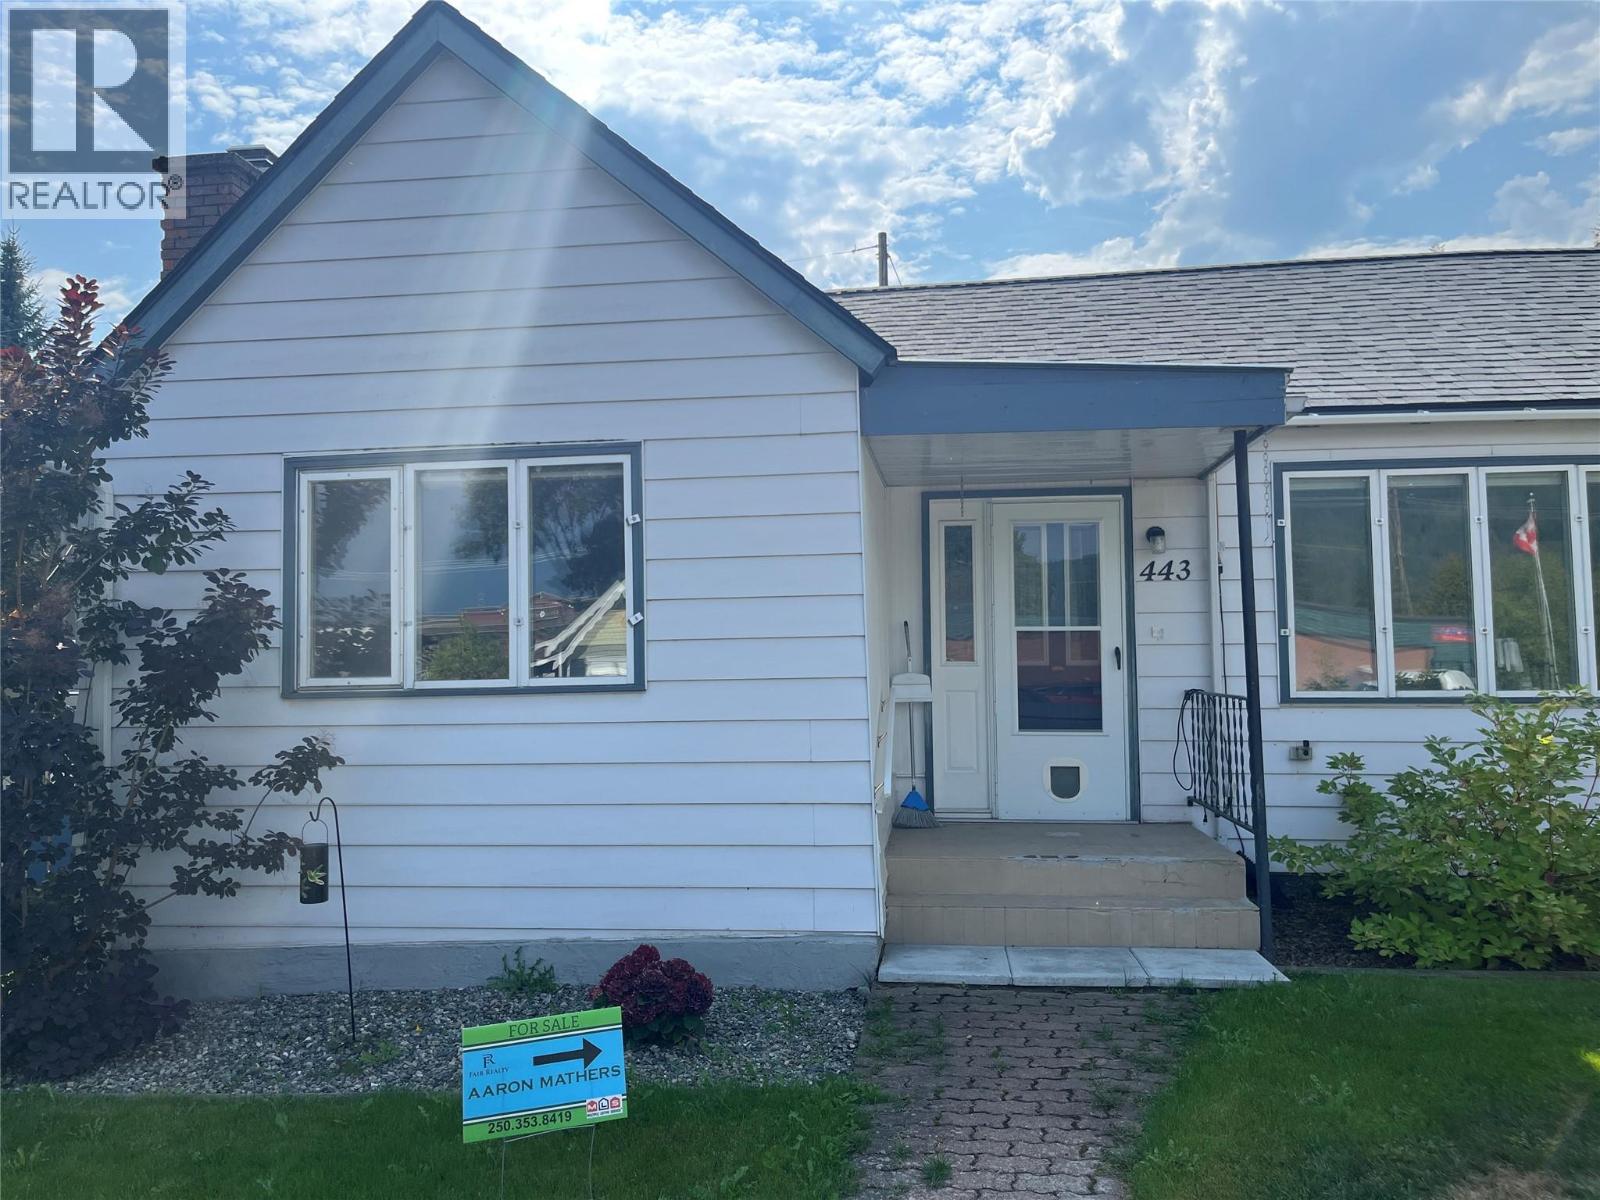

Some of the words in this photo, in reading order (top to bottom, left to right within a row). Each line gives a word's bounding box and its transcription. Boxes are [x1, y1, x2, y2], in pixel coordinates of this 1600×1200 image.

[1139, 559, 1191, 582] 443
[508, 1022, 539, 1038] FOR
[543, 1015, 581, 1033] SALE
[468, 1079, 534, 1100] AARON
[540, 1065, 621, 1089] MATHERS
[488, 1111, 572, 1135] 250.353.8419
